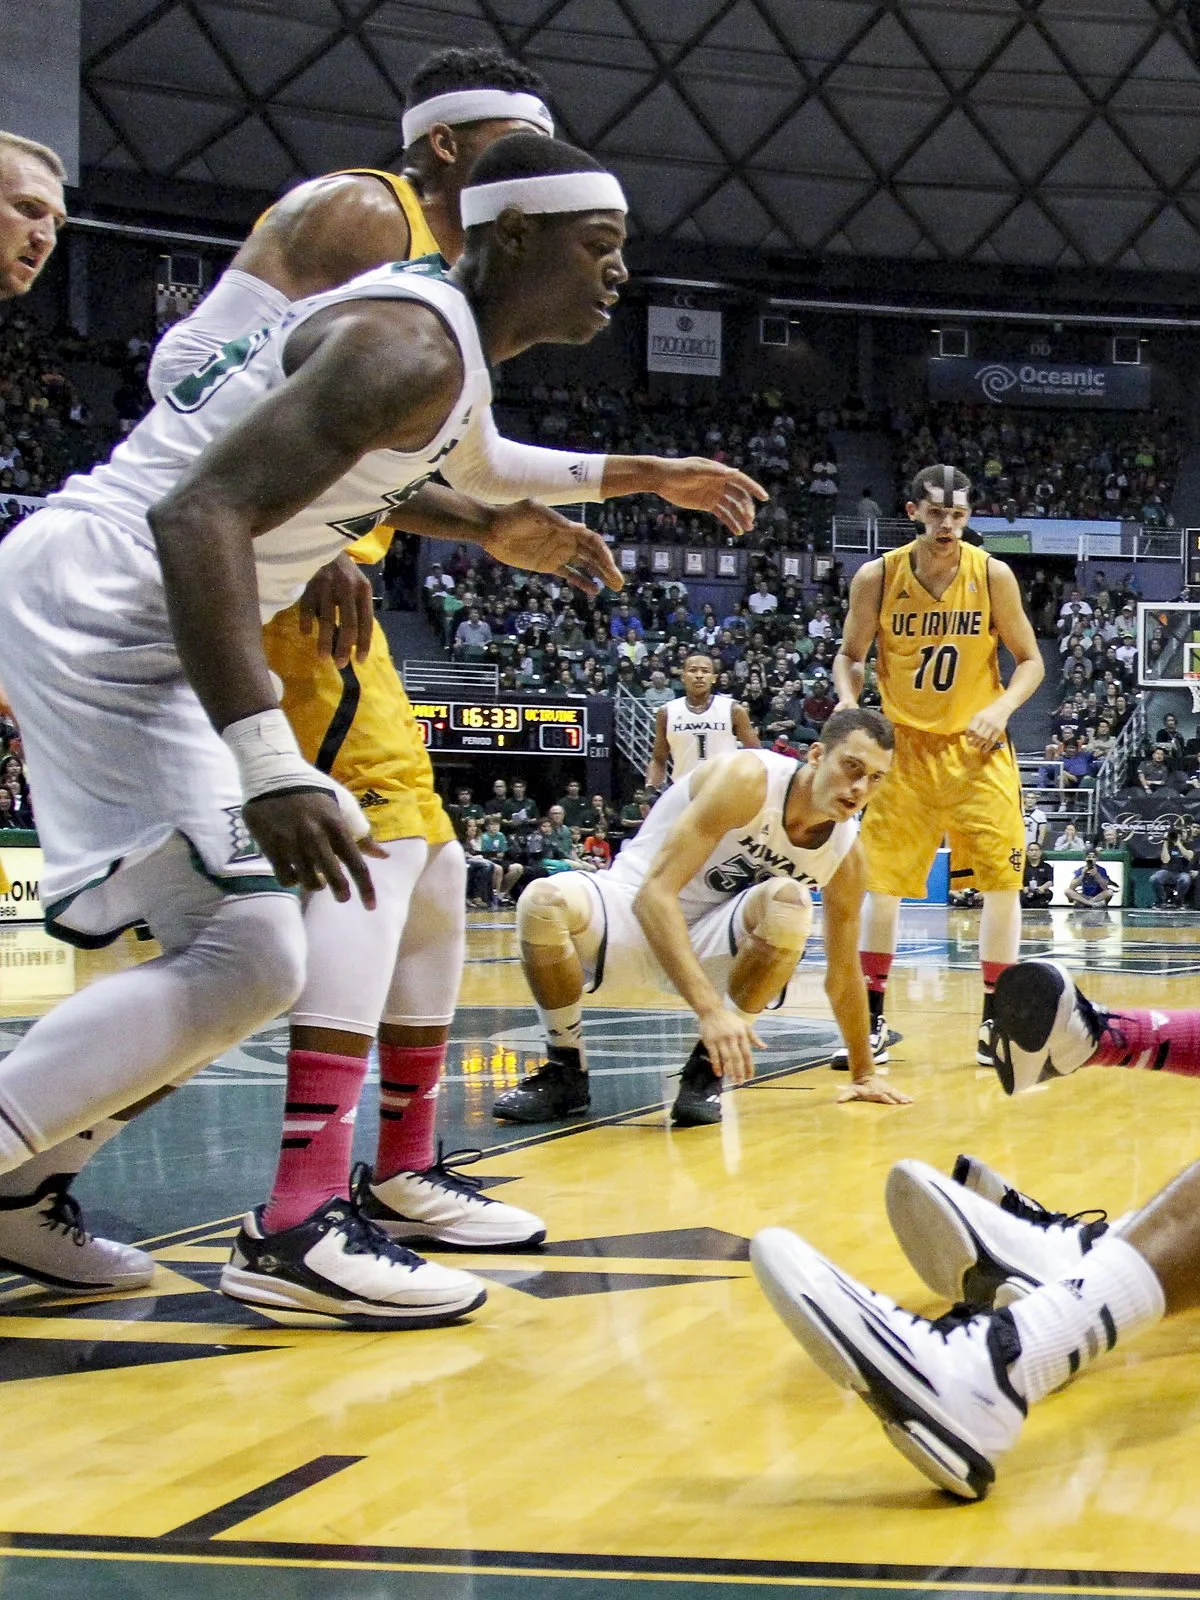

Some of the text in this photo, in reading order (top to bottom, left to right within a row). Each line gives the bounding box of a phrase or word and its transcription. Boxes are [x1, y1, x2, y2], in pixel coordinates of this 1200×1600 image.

[1019, 366, 1105, 386] Oceanic
[892, 610, 982, 636] UC IRVINE
[914, 644, 958, 692] 10
[462, 707, 518, 729] 16:33
[673, 722, 726, 732] HAWAII
[462, 736, 492, 746] PERIOD
[564, 728, 580, 747] 7
[693, 732, 707, 760] 1
[589, 747, 610, 758] EXIT
